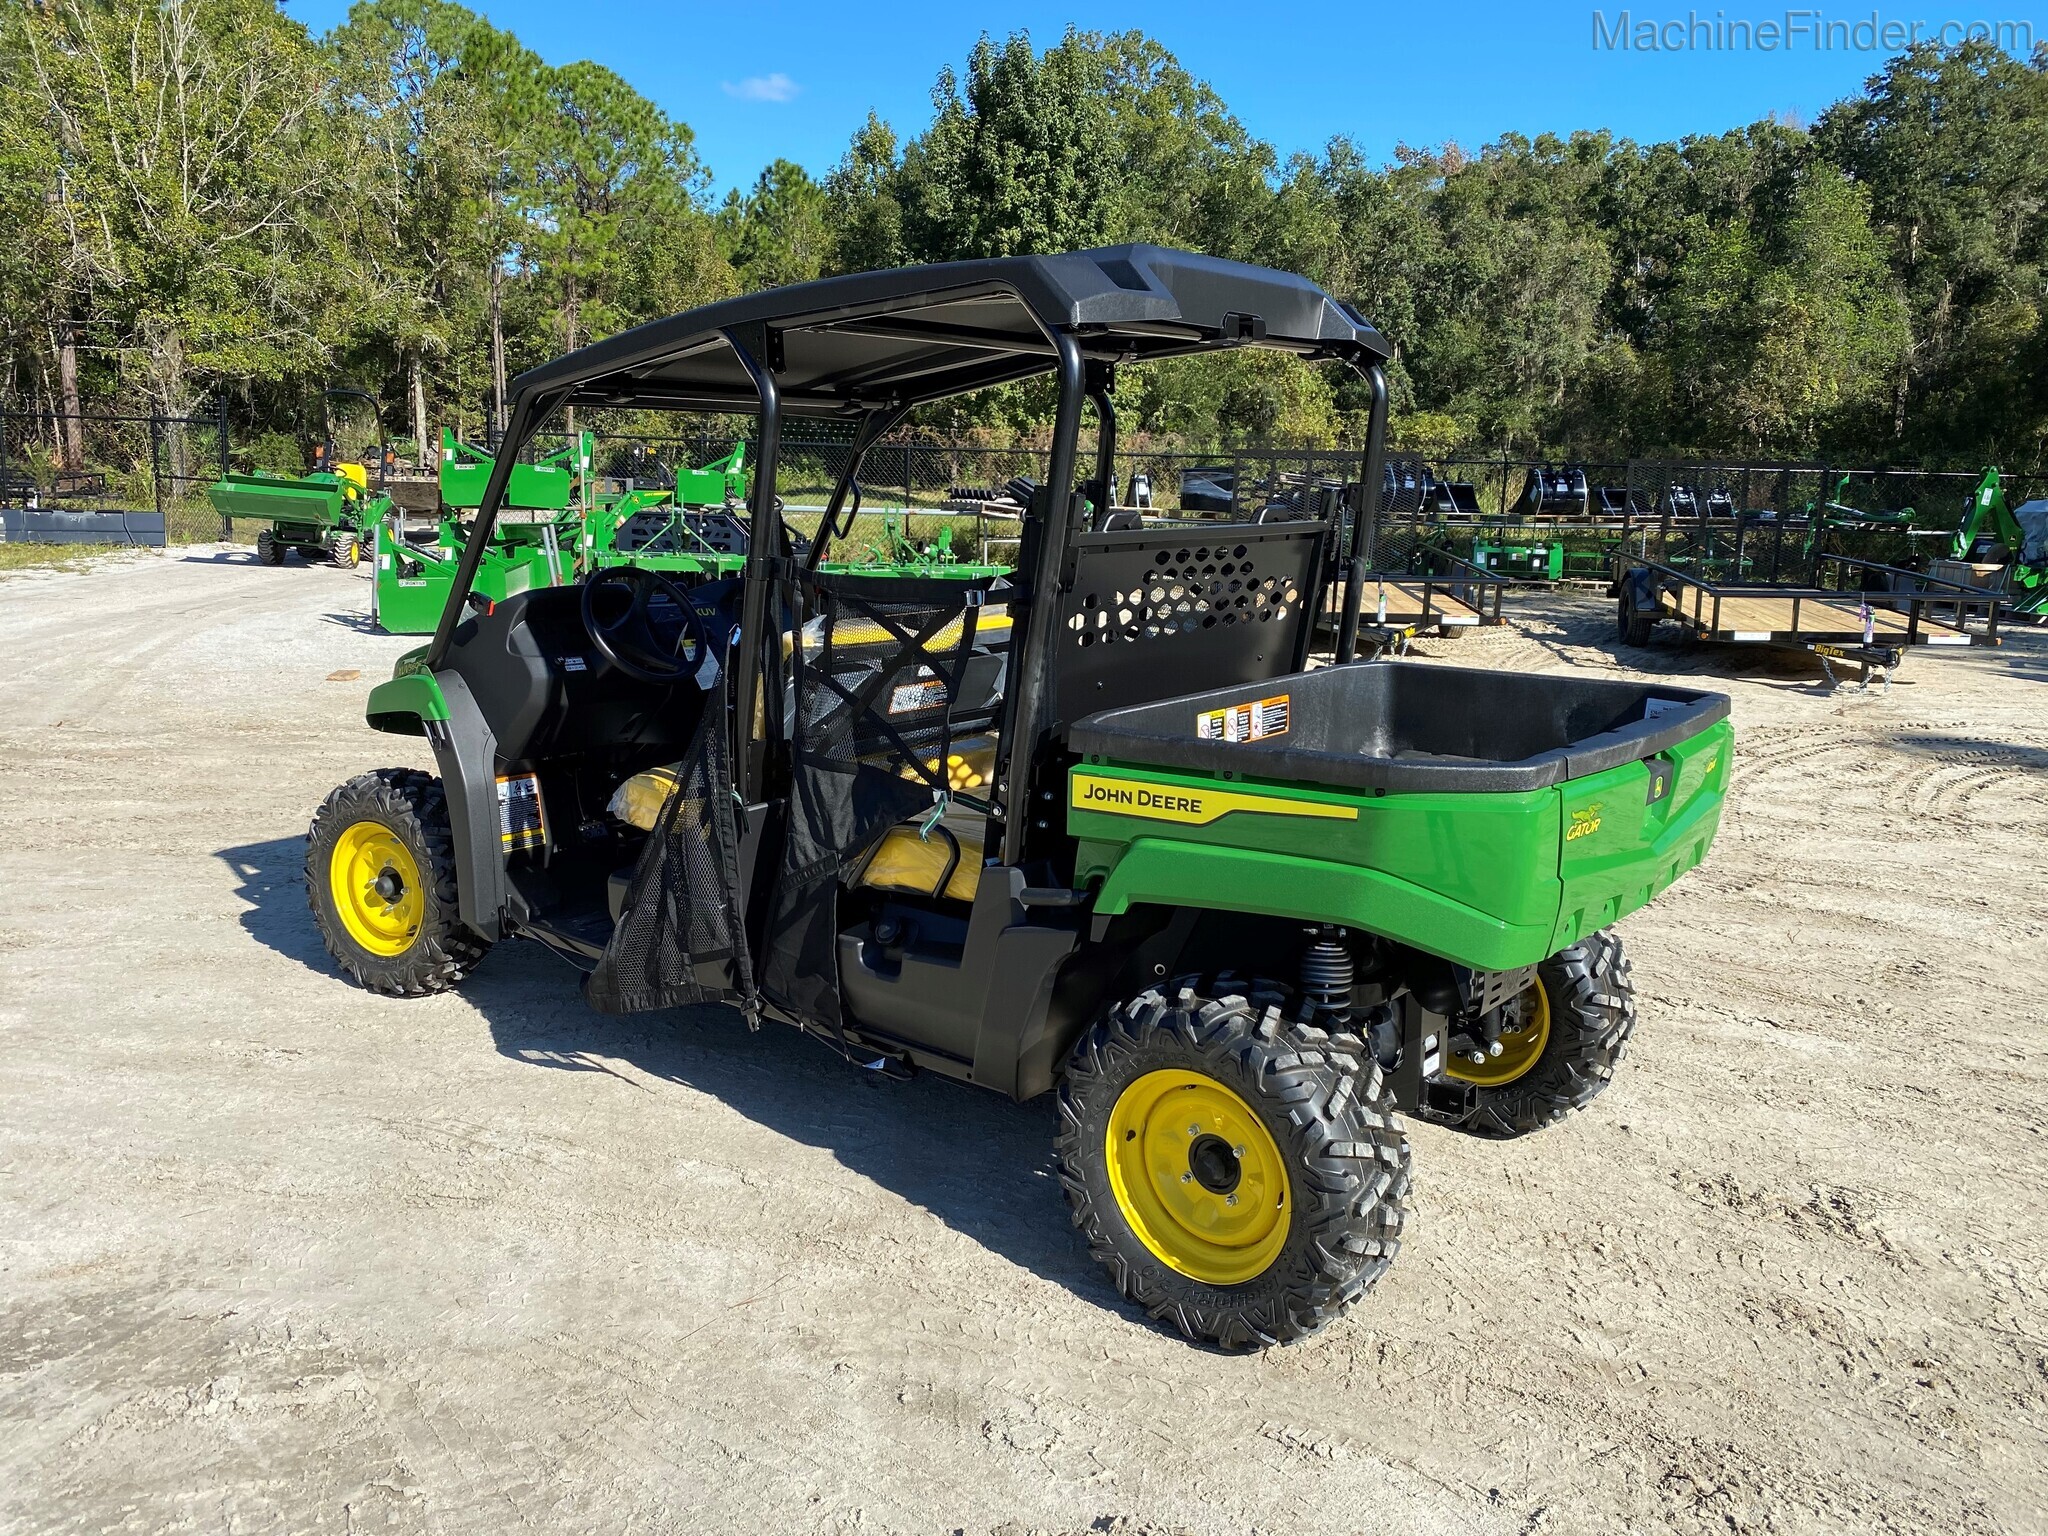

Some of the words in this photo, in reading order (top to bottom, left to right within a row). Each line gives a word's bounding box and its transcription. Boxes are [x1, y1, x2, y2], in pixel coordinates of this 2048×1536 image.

[1815, 644, 1845, 657] BigTex
[1084, 784, 1132, 804] JOHN
[1137, 790, 1202, 813] DEERE
[1566, 817, 1601, 841] GATOR
